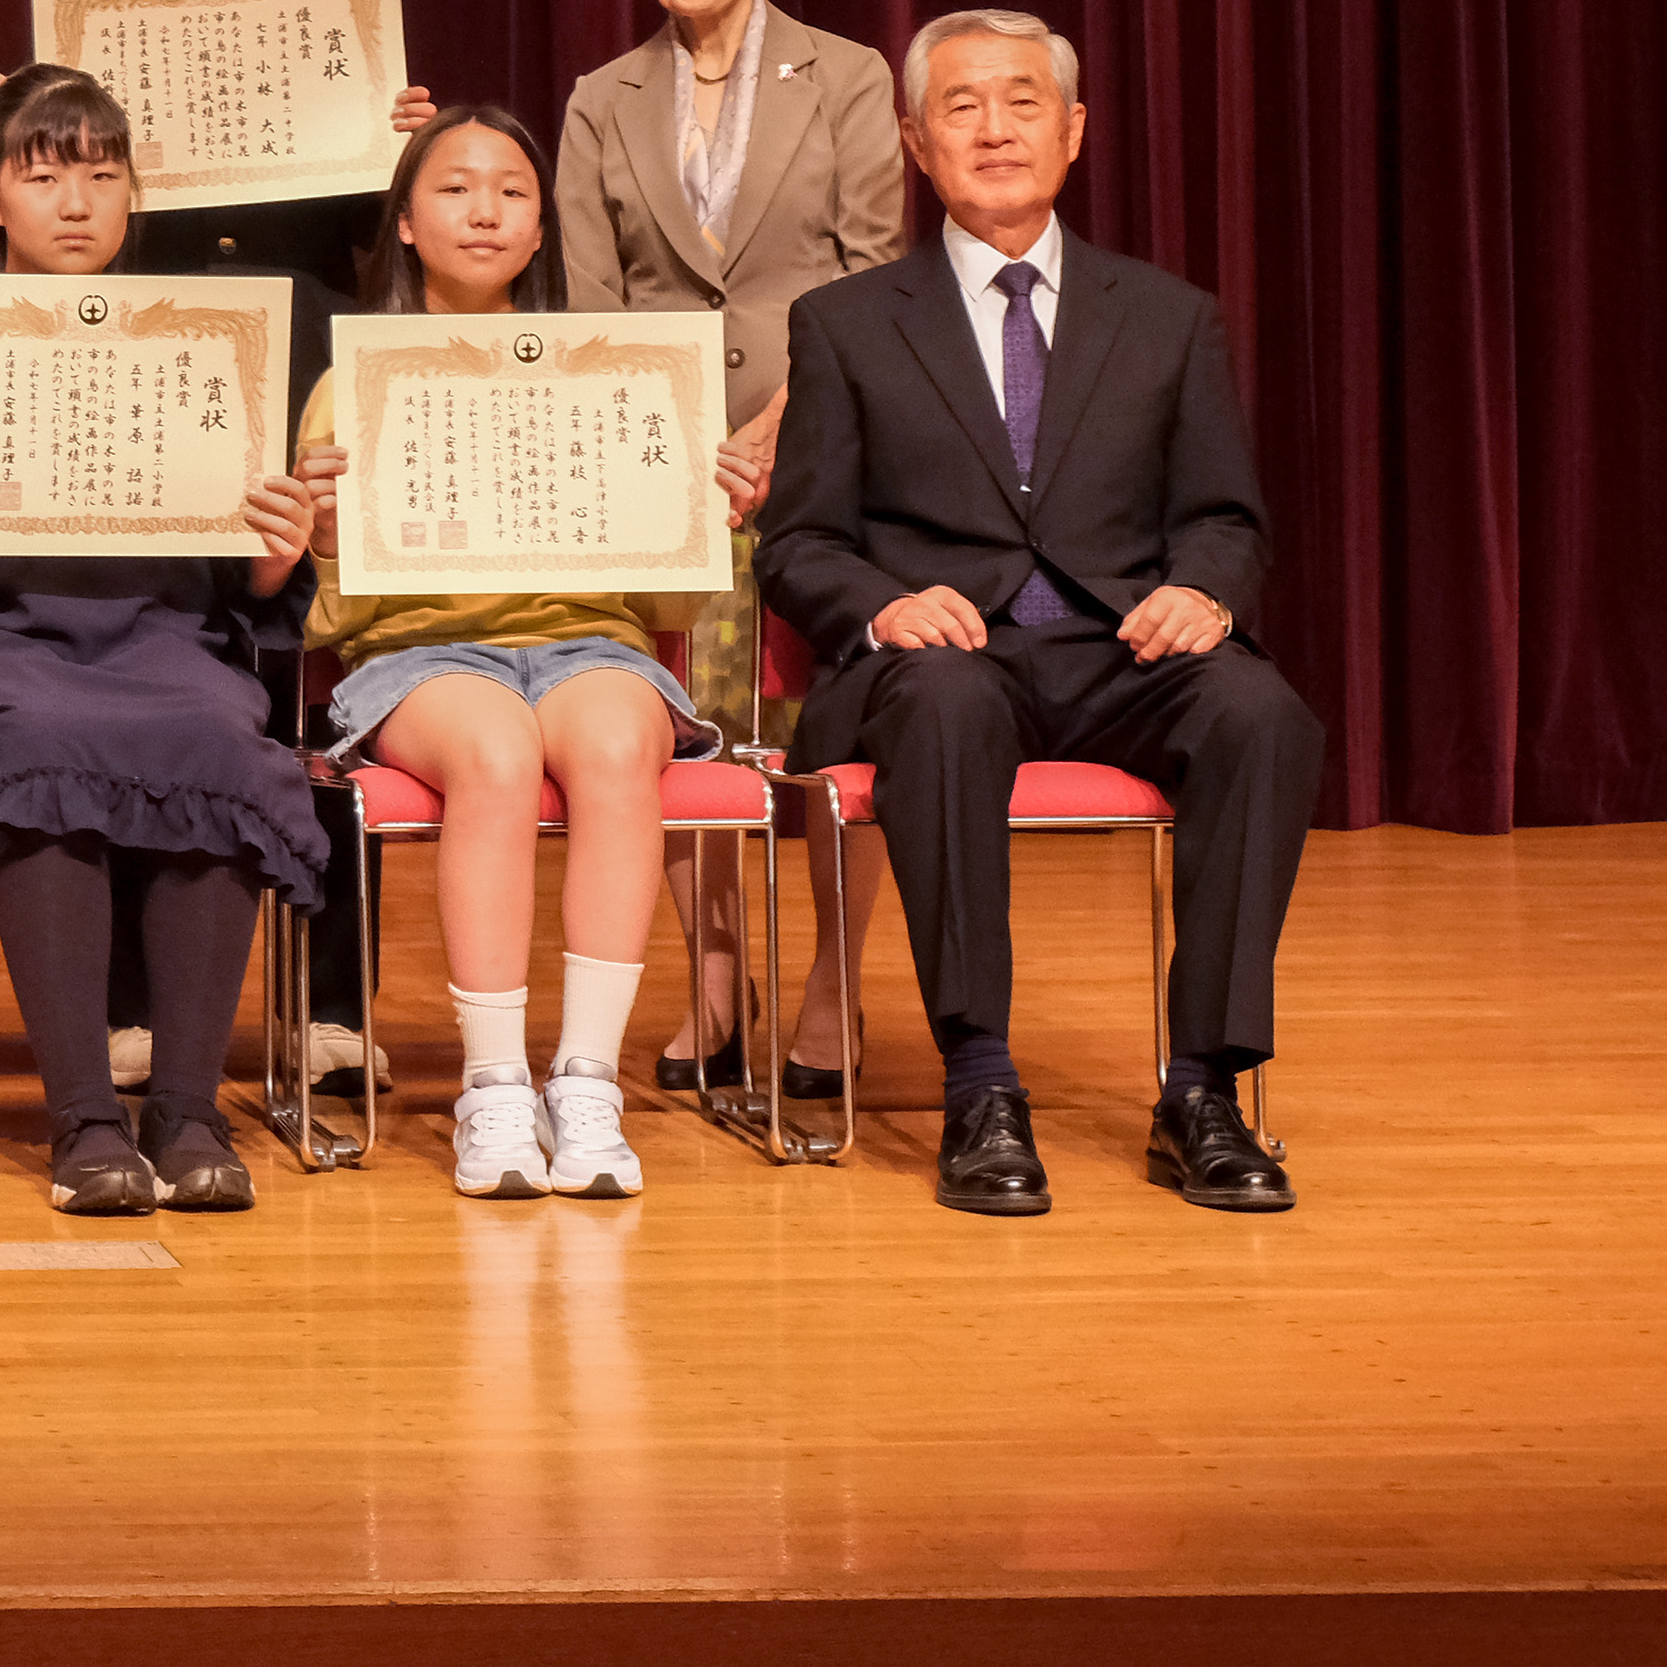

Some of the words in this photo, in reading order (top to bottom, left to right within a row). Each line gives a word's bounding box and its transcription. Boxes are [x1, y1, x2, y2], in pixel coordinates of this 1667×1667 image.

[256, 23, 268, 48] 七年
[295, 6, 313, 60] 優良賞
[323, 28, 351, 81] 賞状
[255, 60, 274, 97] 小林
[130, 363, 143, 391] 五年
[175, 351, 193, 408] 優良賞
[199, 376, 228, 433] 賞状
[569, 405, 582, 431] 五年
[612, 387, 631, 444] 優良賞
[151, 364, 166, 508] 土浦市立土浦第二小学校
[641, 412, 670, 468] 賞状
[570, 506, 589, 544] 心音
